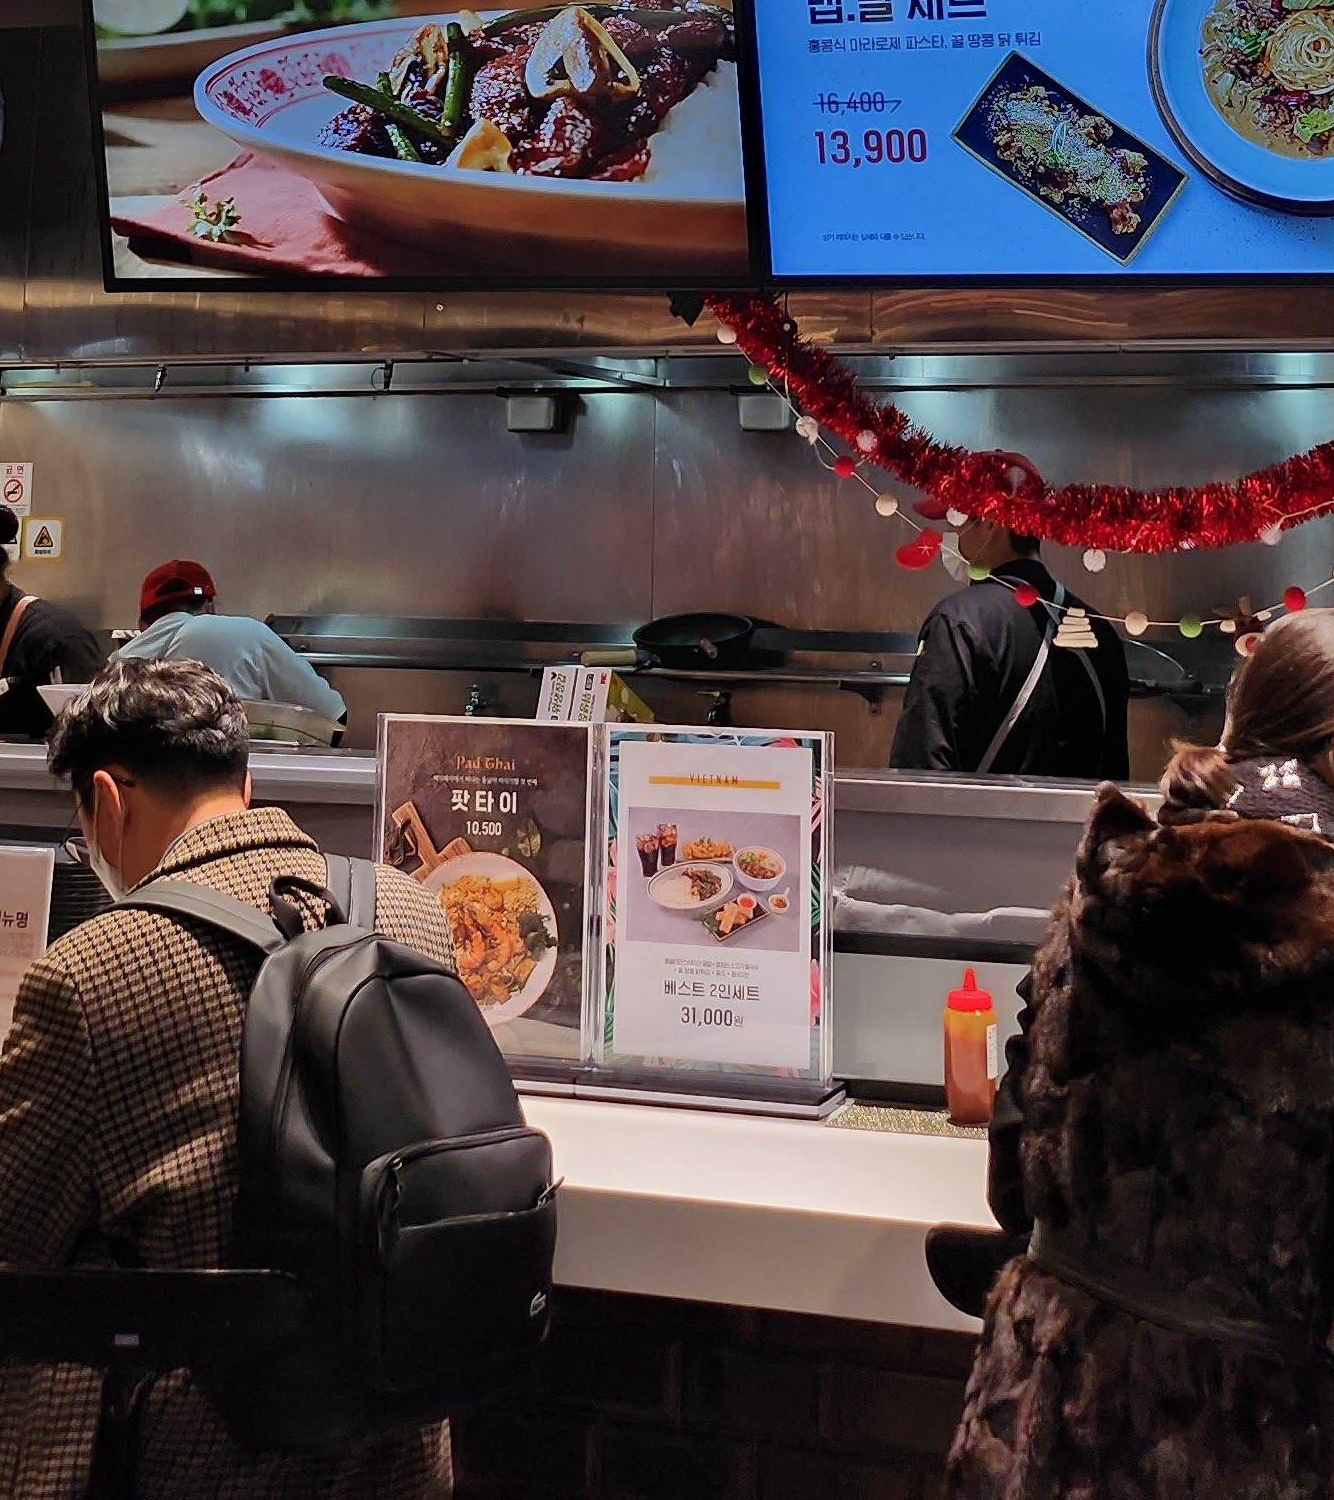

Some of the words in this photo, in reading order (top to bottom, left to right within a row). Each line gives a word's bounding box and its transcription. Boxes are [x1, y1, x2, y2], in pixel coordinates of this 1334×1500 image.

[807, 37, 847, 53] 홍콩식
[850, 36, 902, 52] 마라로제
[905, 35, 948, 51] 파스타,
[950, 34, 965, 49] 꿀
[968, 33, 995, 49] 땅콩
[998, 32, 1012, 48] 닭
[1014, 31, 1042, 47] 튀김
[817, 91, 886, 117] 16,400
[814, 128, 928, 169] 13,900
[456, 755, 481, 770] Pad
[689, 773, 739, 785] VIETNAM
[664, 979, 706, 997] 베스트
[709, 983, 760, 1002] 2인세트
[680, 1006, 744, 1028] 31,000원
